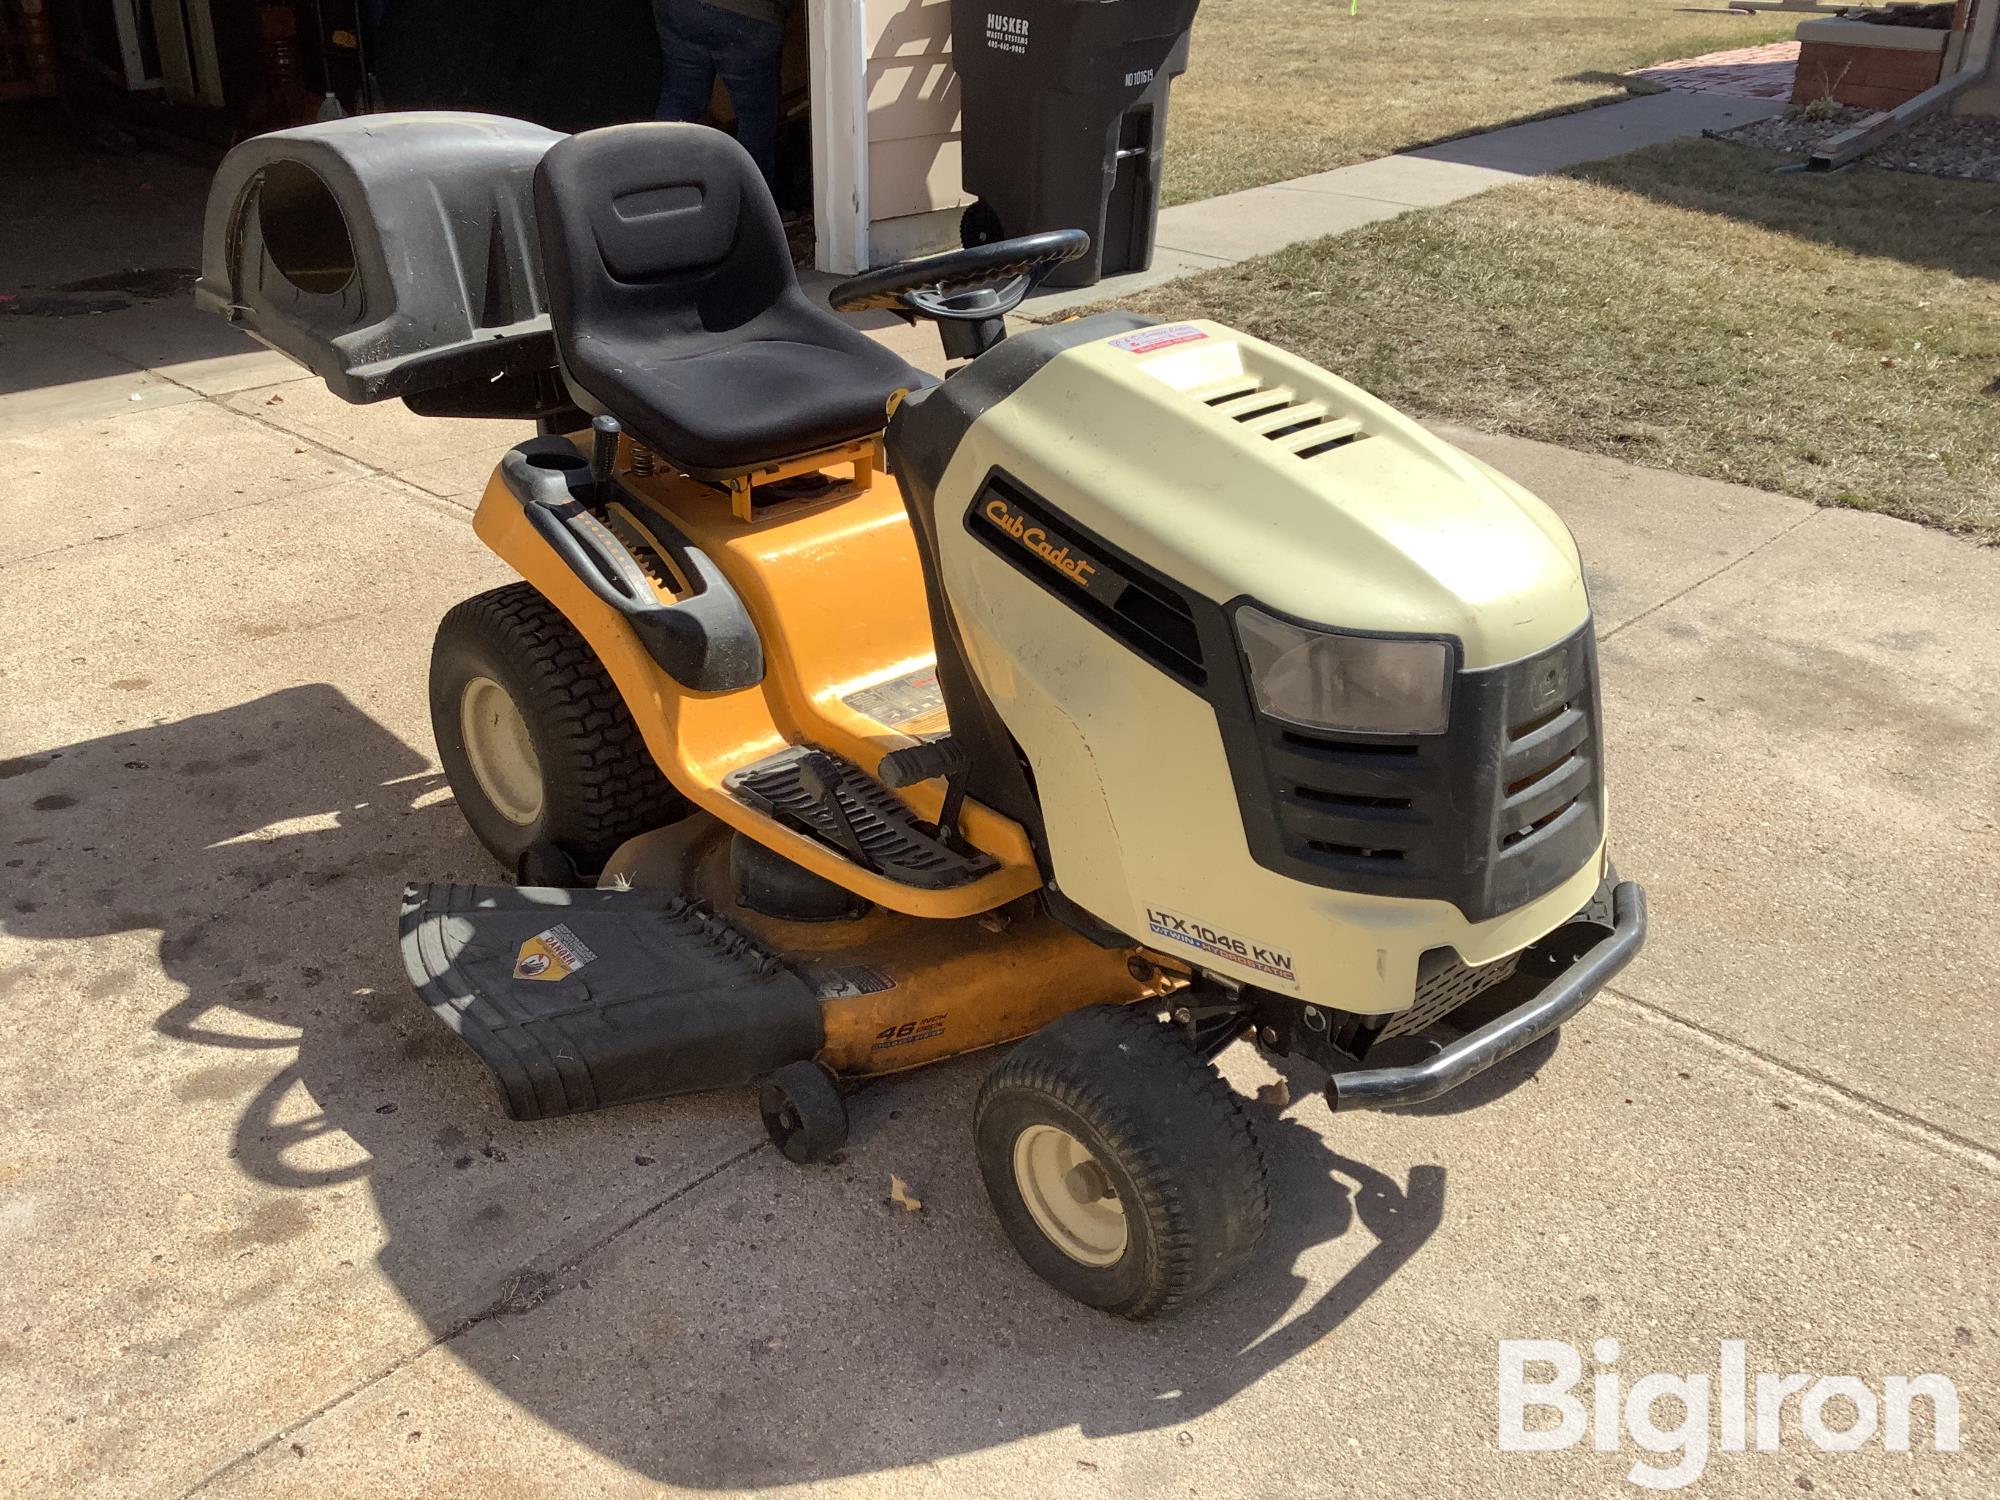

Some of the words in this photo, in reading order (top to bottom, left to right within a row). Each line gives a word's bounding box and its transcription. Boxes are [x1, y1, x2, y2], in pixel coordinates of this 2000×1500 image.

[987, 13, 1029, 36] HUSKER
[985, 500, 1025, 538] Cub
[1022, 528, 1096, 586] Cadet
[545, 936, 577, 967] DANGER
[1146, 908, 1189, 935] LTX
[1191, 924, 1248, 956] 1046
[1252, 945, 1292, 971] KW
[1200, 943, 1295, 981] HYDROSTATIC
[875, 1021, 918, 1041] 46
